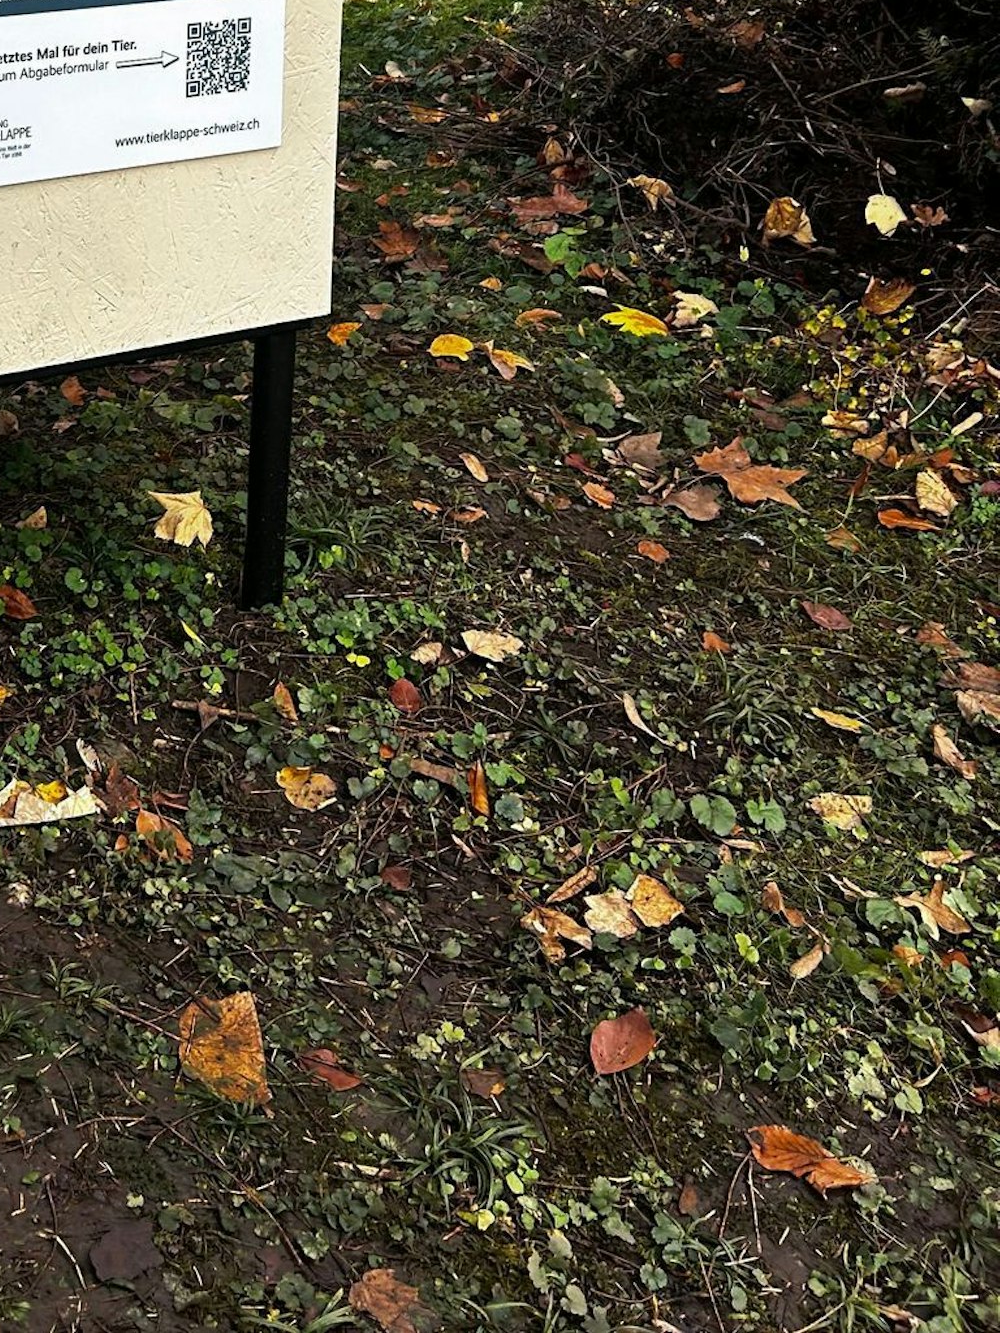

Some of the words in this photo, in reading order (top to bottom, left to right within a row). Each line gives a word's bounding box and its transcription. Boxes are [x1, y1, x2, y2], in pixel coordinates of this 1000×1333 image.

[37, 46, 59, 60] Mal
[63, 45, 79, 57] für
[83, 42, 108, 55] dein
[111, 39, 138, 51] Tier.
[19, 59, 109, 81] Abgabeformular
[115, 117, 260, 148] www.tierklappe-schweiz.ch
